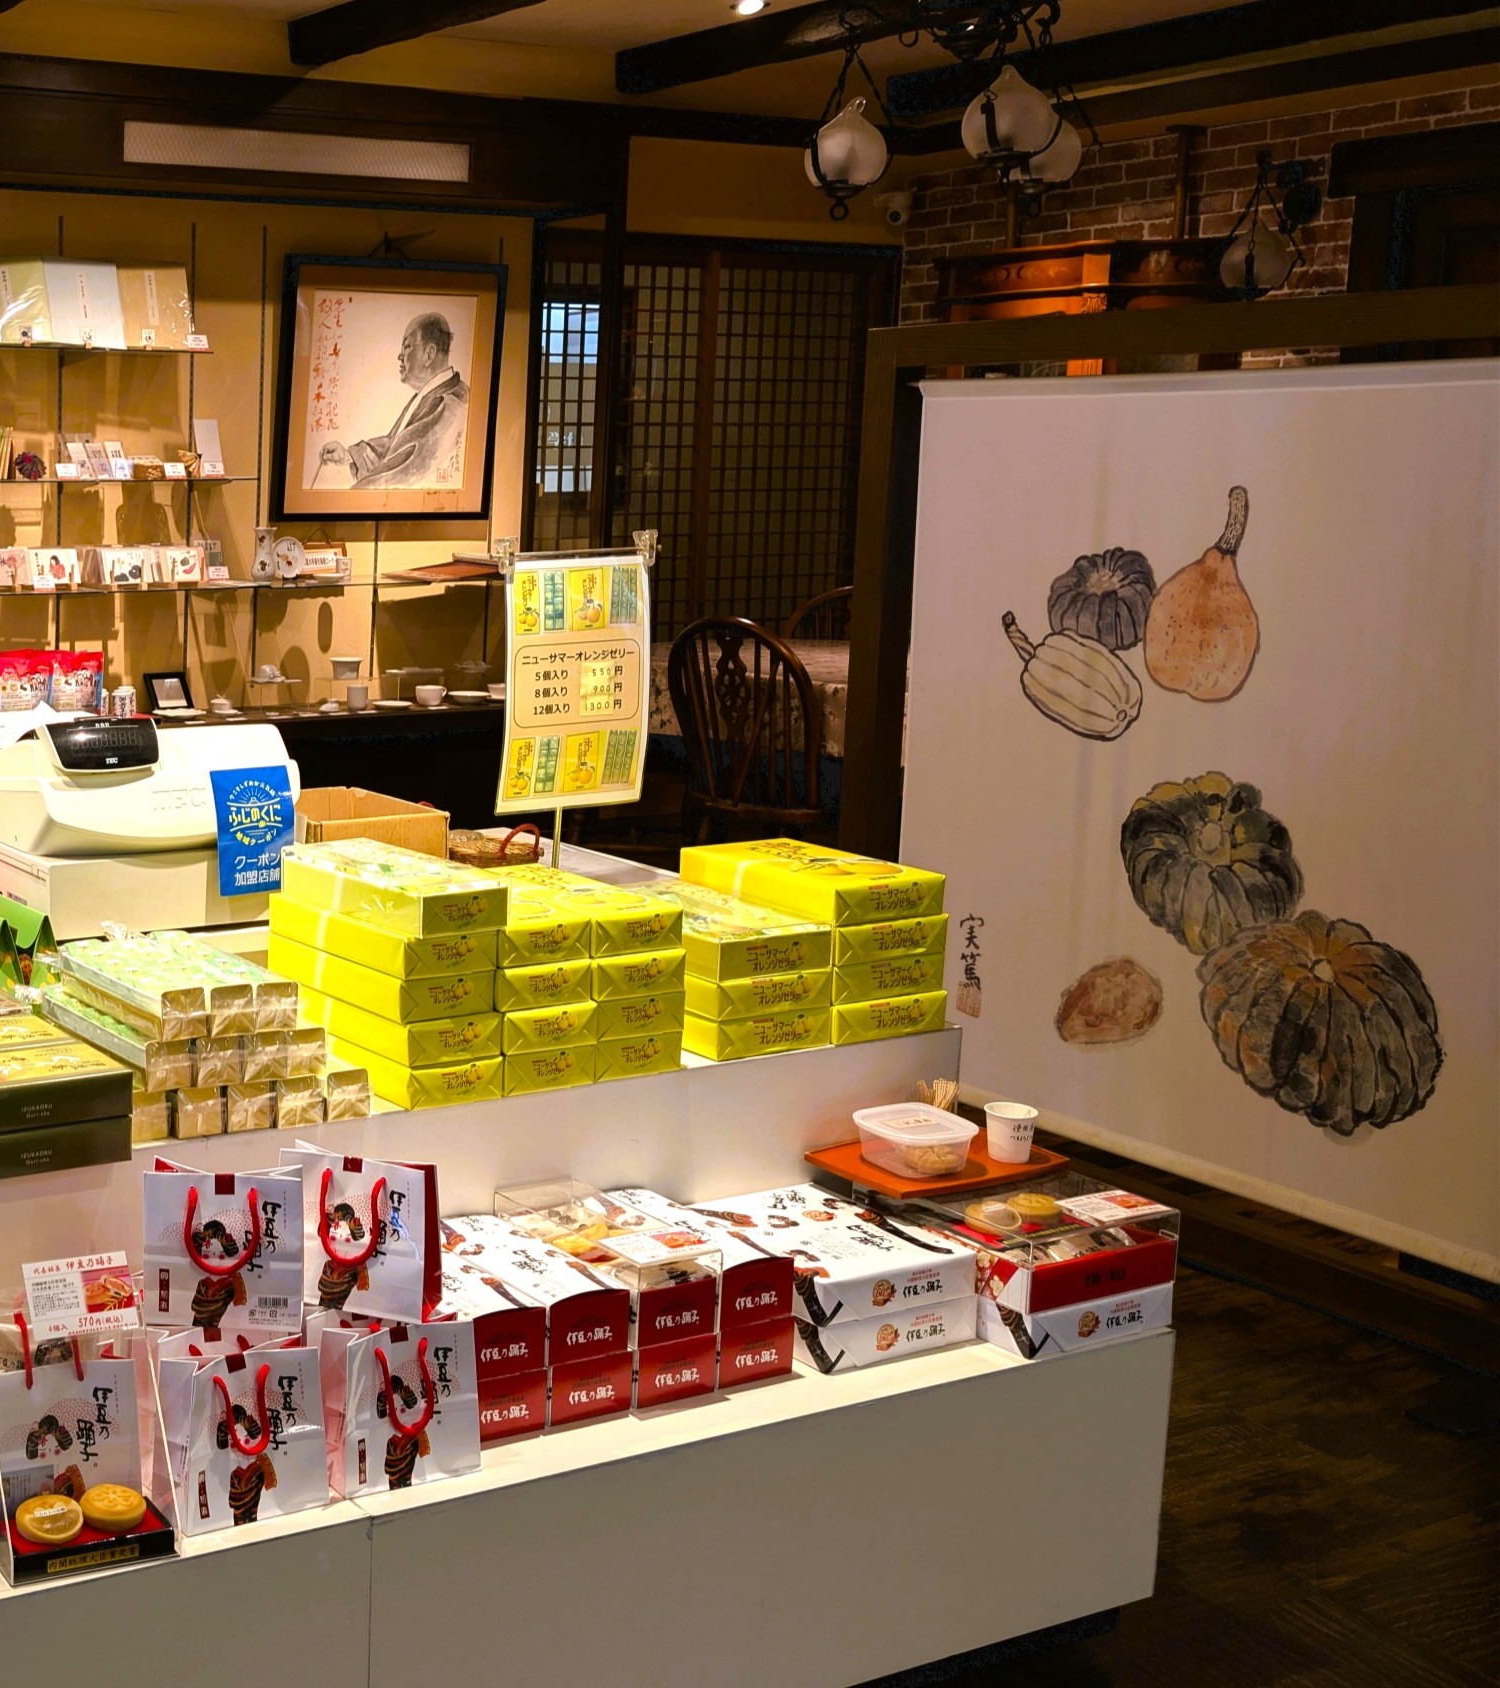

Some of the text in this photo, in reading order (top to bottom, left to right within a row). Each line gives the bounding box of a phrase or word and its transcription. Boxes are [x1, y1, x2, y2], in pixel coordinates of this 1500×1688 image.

[522, 648, 635, 665] ニューサマーオレンジゼリー
[535, 670, 568, 681] 5個入り
[534, 686, 568, 698] 8個入り
[533, 703, 571, 716] 12個入り
[229, 804, 282, 826] ふじのくに
[235, 852, 280, 870] クーポン
[235, 867, 280, 886] 加盟店舗
[21, 1103, 52, 1112] IZUKAORU
